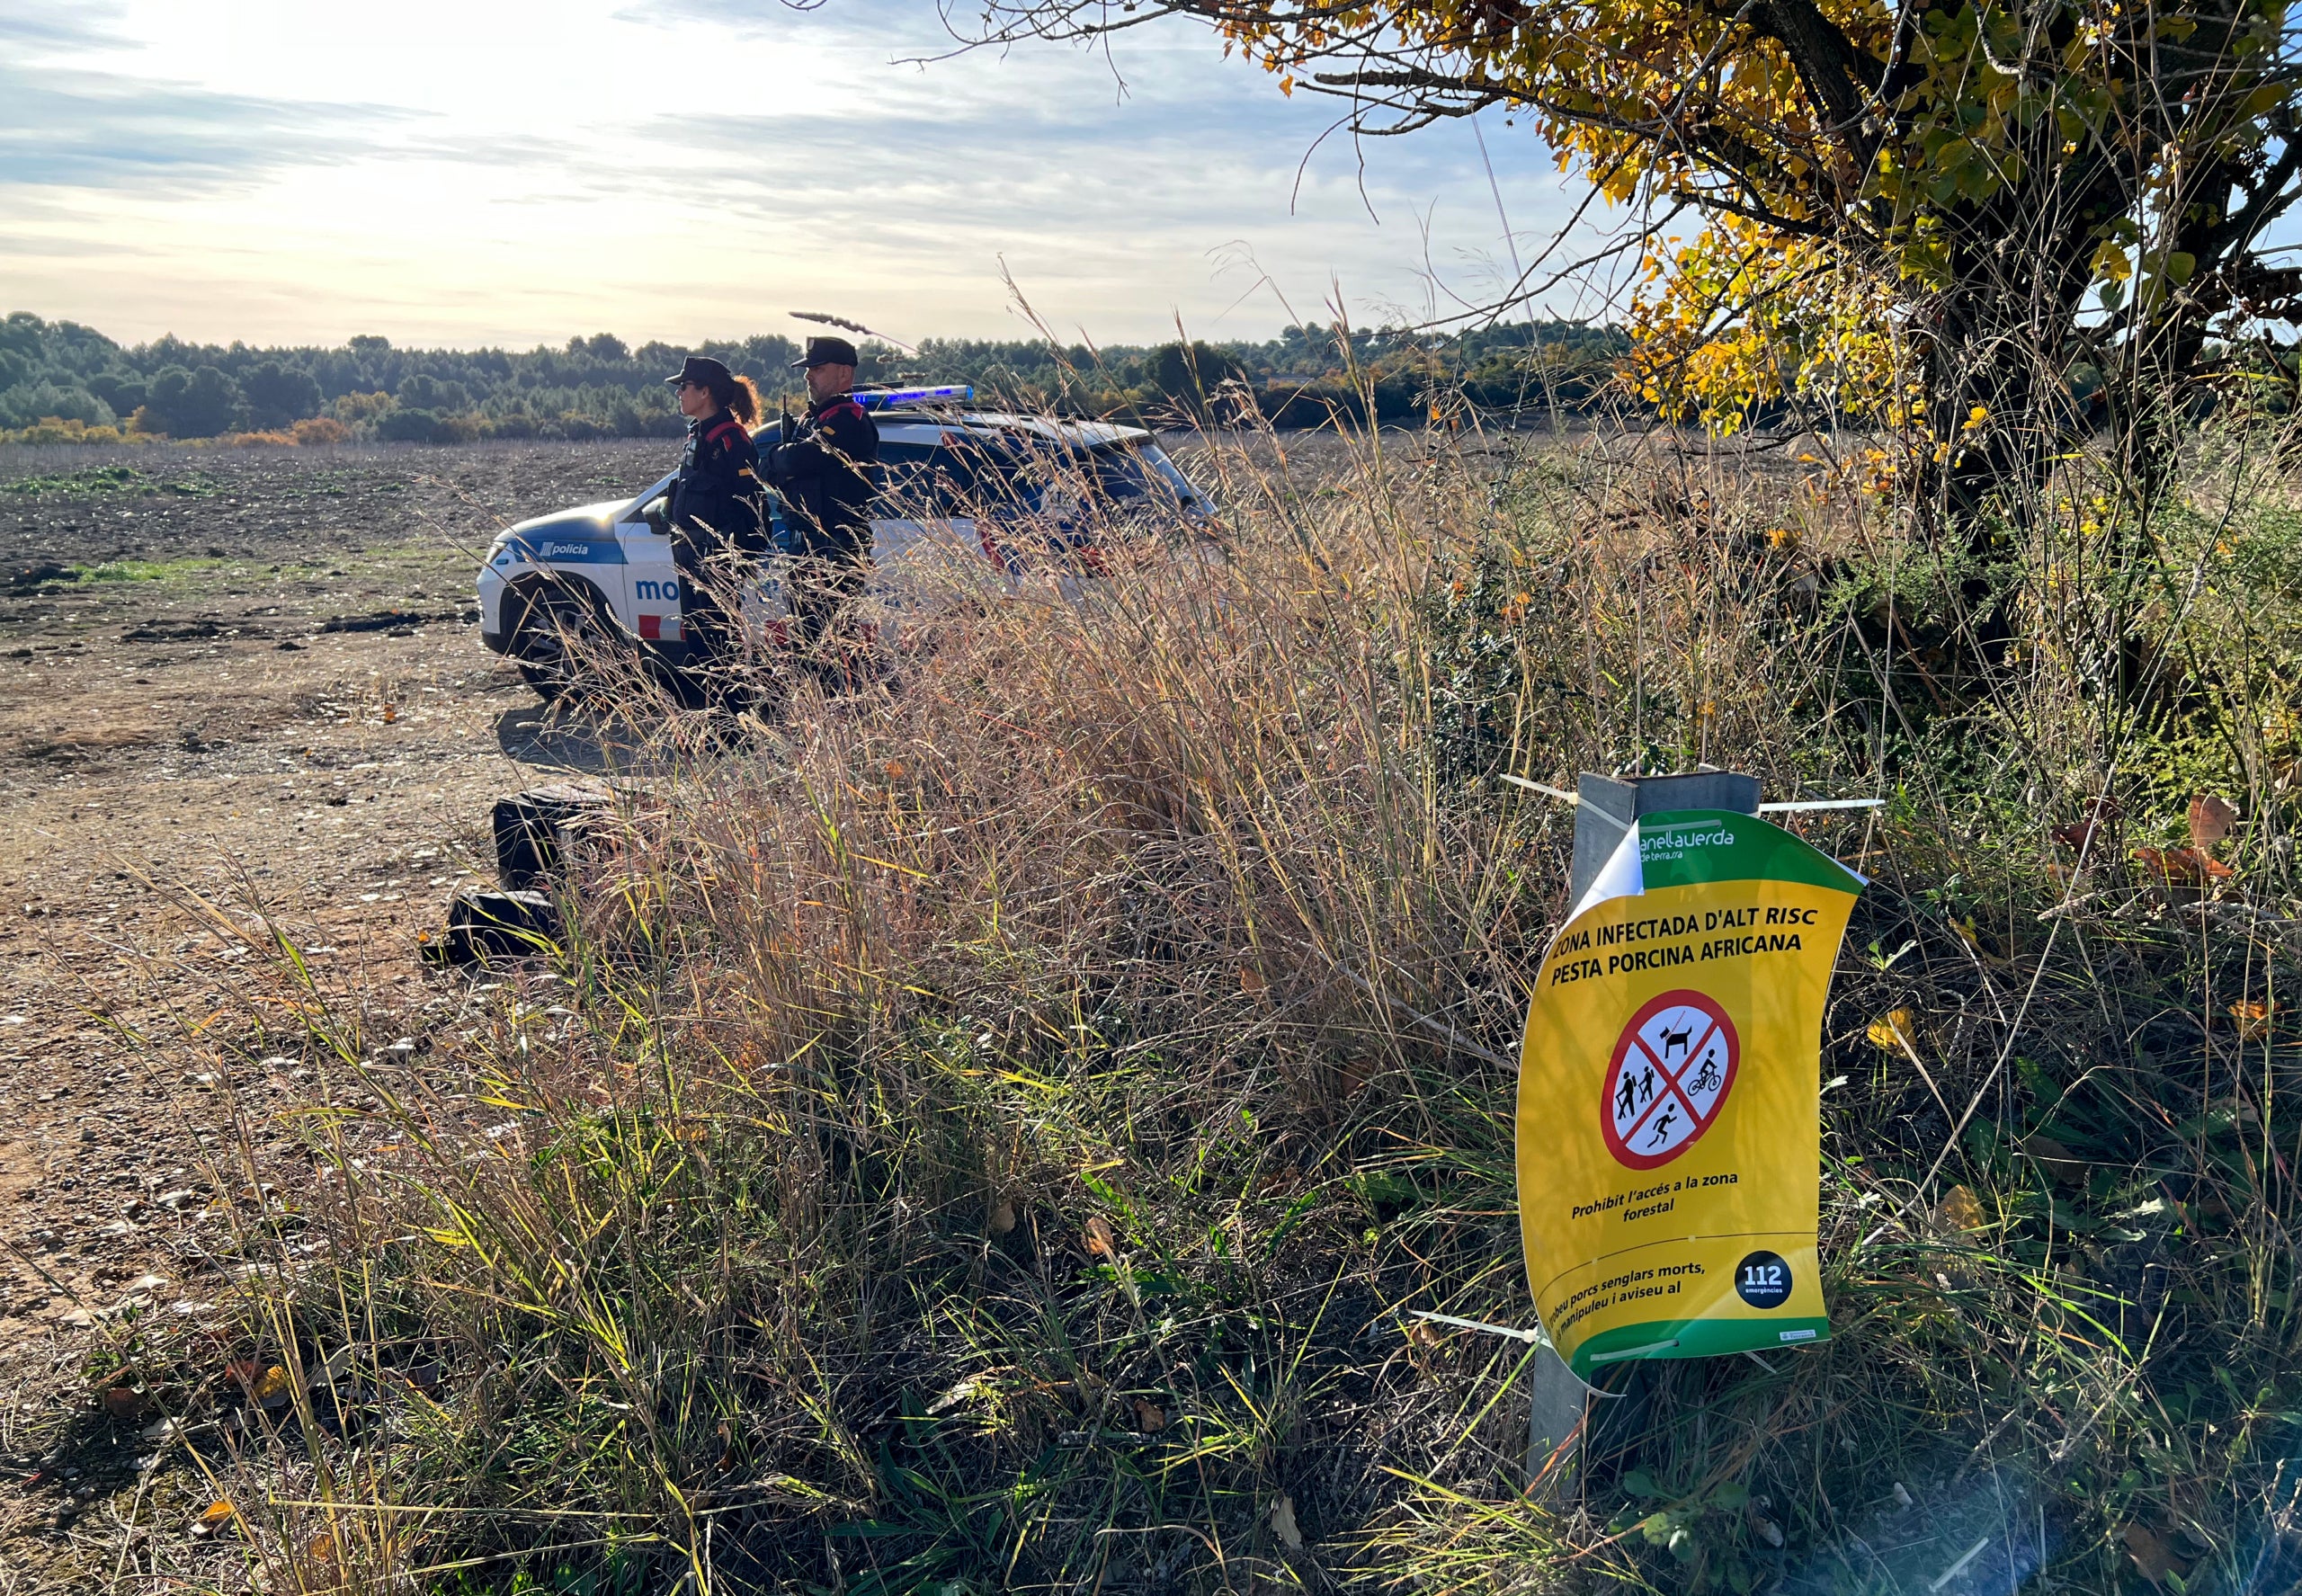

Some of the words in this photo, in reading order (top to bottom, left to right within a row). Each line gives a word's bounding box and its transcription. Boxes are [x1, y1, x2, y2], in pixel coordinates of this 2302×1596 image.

[552, 543, 589, 556] policia
[1553, 930, 1591, 959] ZONA
[1597, 914, 1699, 946] INFECTADA
[1705, 908, 1760, 931] D'ALT
[1765, 907, 1818, 924] RISC
[1551, 958, 1602, 986] PESTA
[1609, 945, 1694, 974] PORCINA
[1700, 933, 1802, 961] AFRICANA
[1572, 1194, 1624, 1219] Prohibit
[1673, 1181, 1682, 1191] a
[1685, 1176, 1698, 1190] la
[1702, 1173, 1737, 1187] zona
[1623, 1198, 1674, 1222] forestal
[1570, 1285, 1598, 1308] porcs
[1601, 1269, 1654, 1291] senglars
[1657, 1262, 1705, 1277] morts,
[1744, 1265, 1782, 1285] 112
[1560, 1297, 1609, 1334] manipuleu
[1611, 1292, 1616, 1304] i
[1619, 1286, 1664, 1302] aviseu
[1667, 1280, 1681, 1294] al
